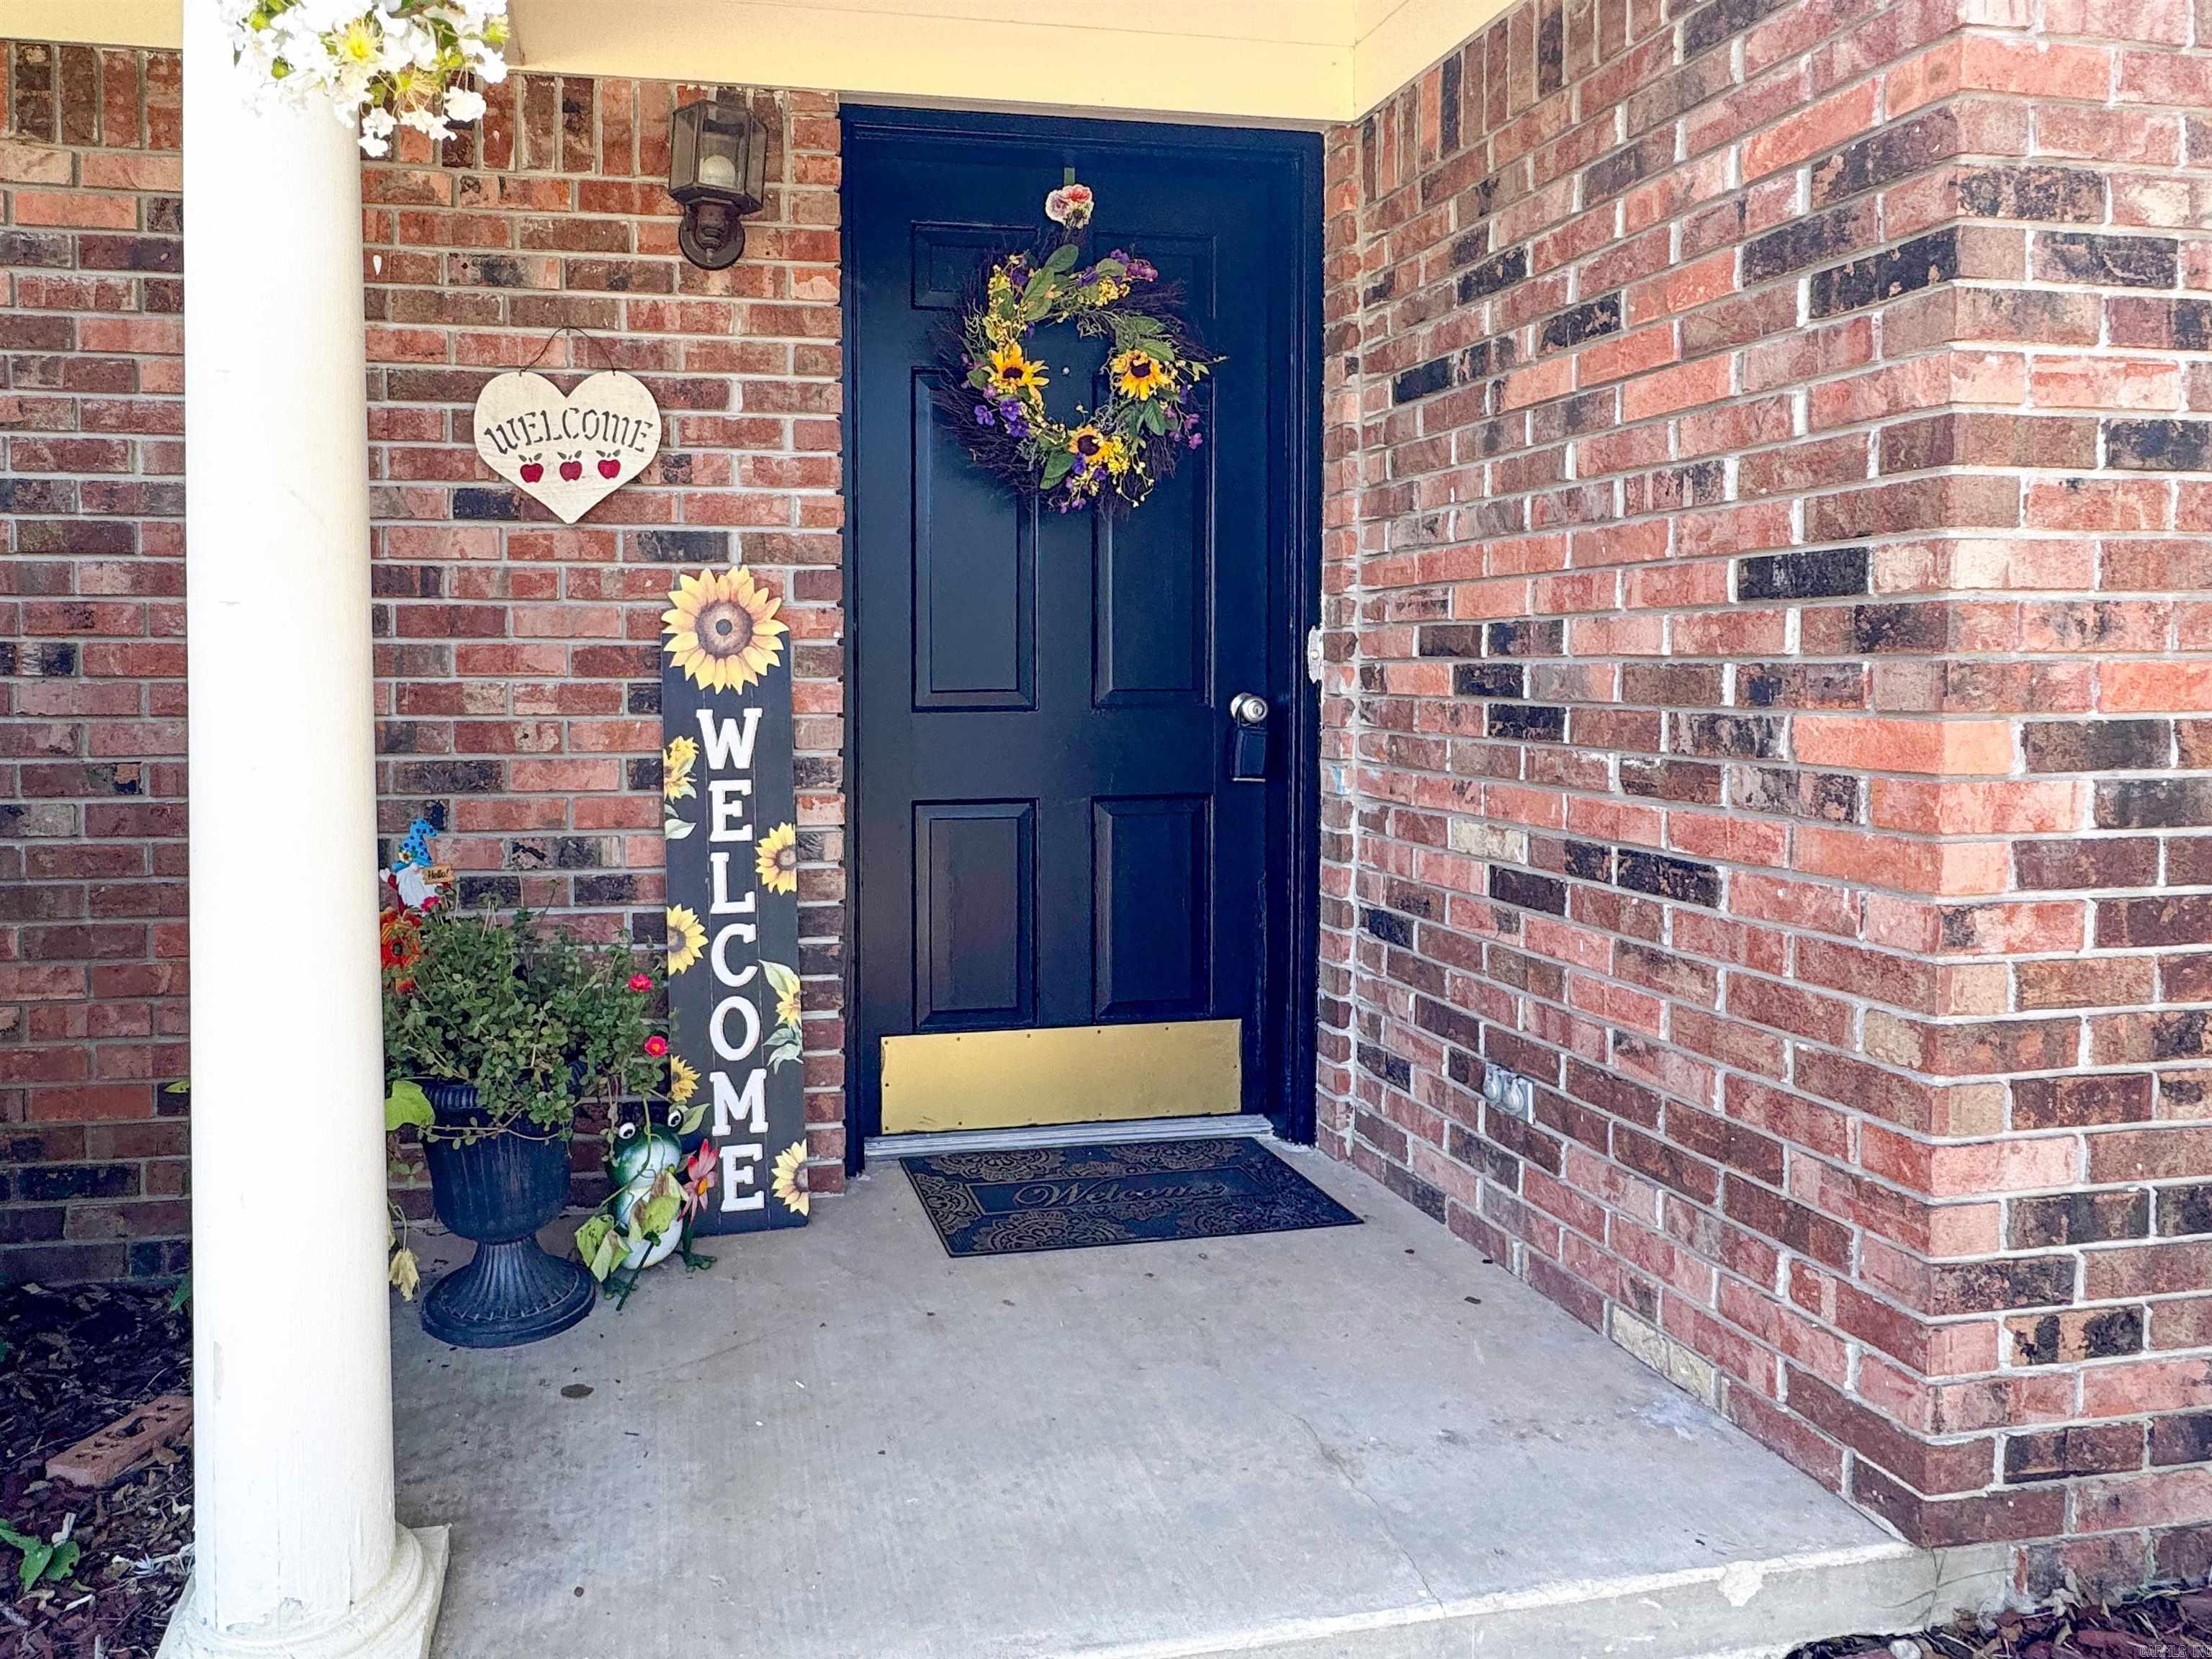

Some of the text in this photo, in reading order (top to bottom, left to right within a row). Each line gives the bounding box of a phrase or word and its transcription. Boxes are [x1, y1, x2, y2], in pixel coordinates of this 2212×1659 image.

[484, 408, 653, 454] WELCOME
[428, 868, 449, 880] Hello!
[696, 708, 768, 1211] WELCOME
[1013, 1177, 1227, 1206] Welcome
